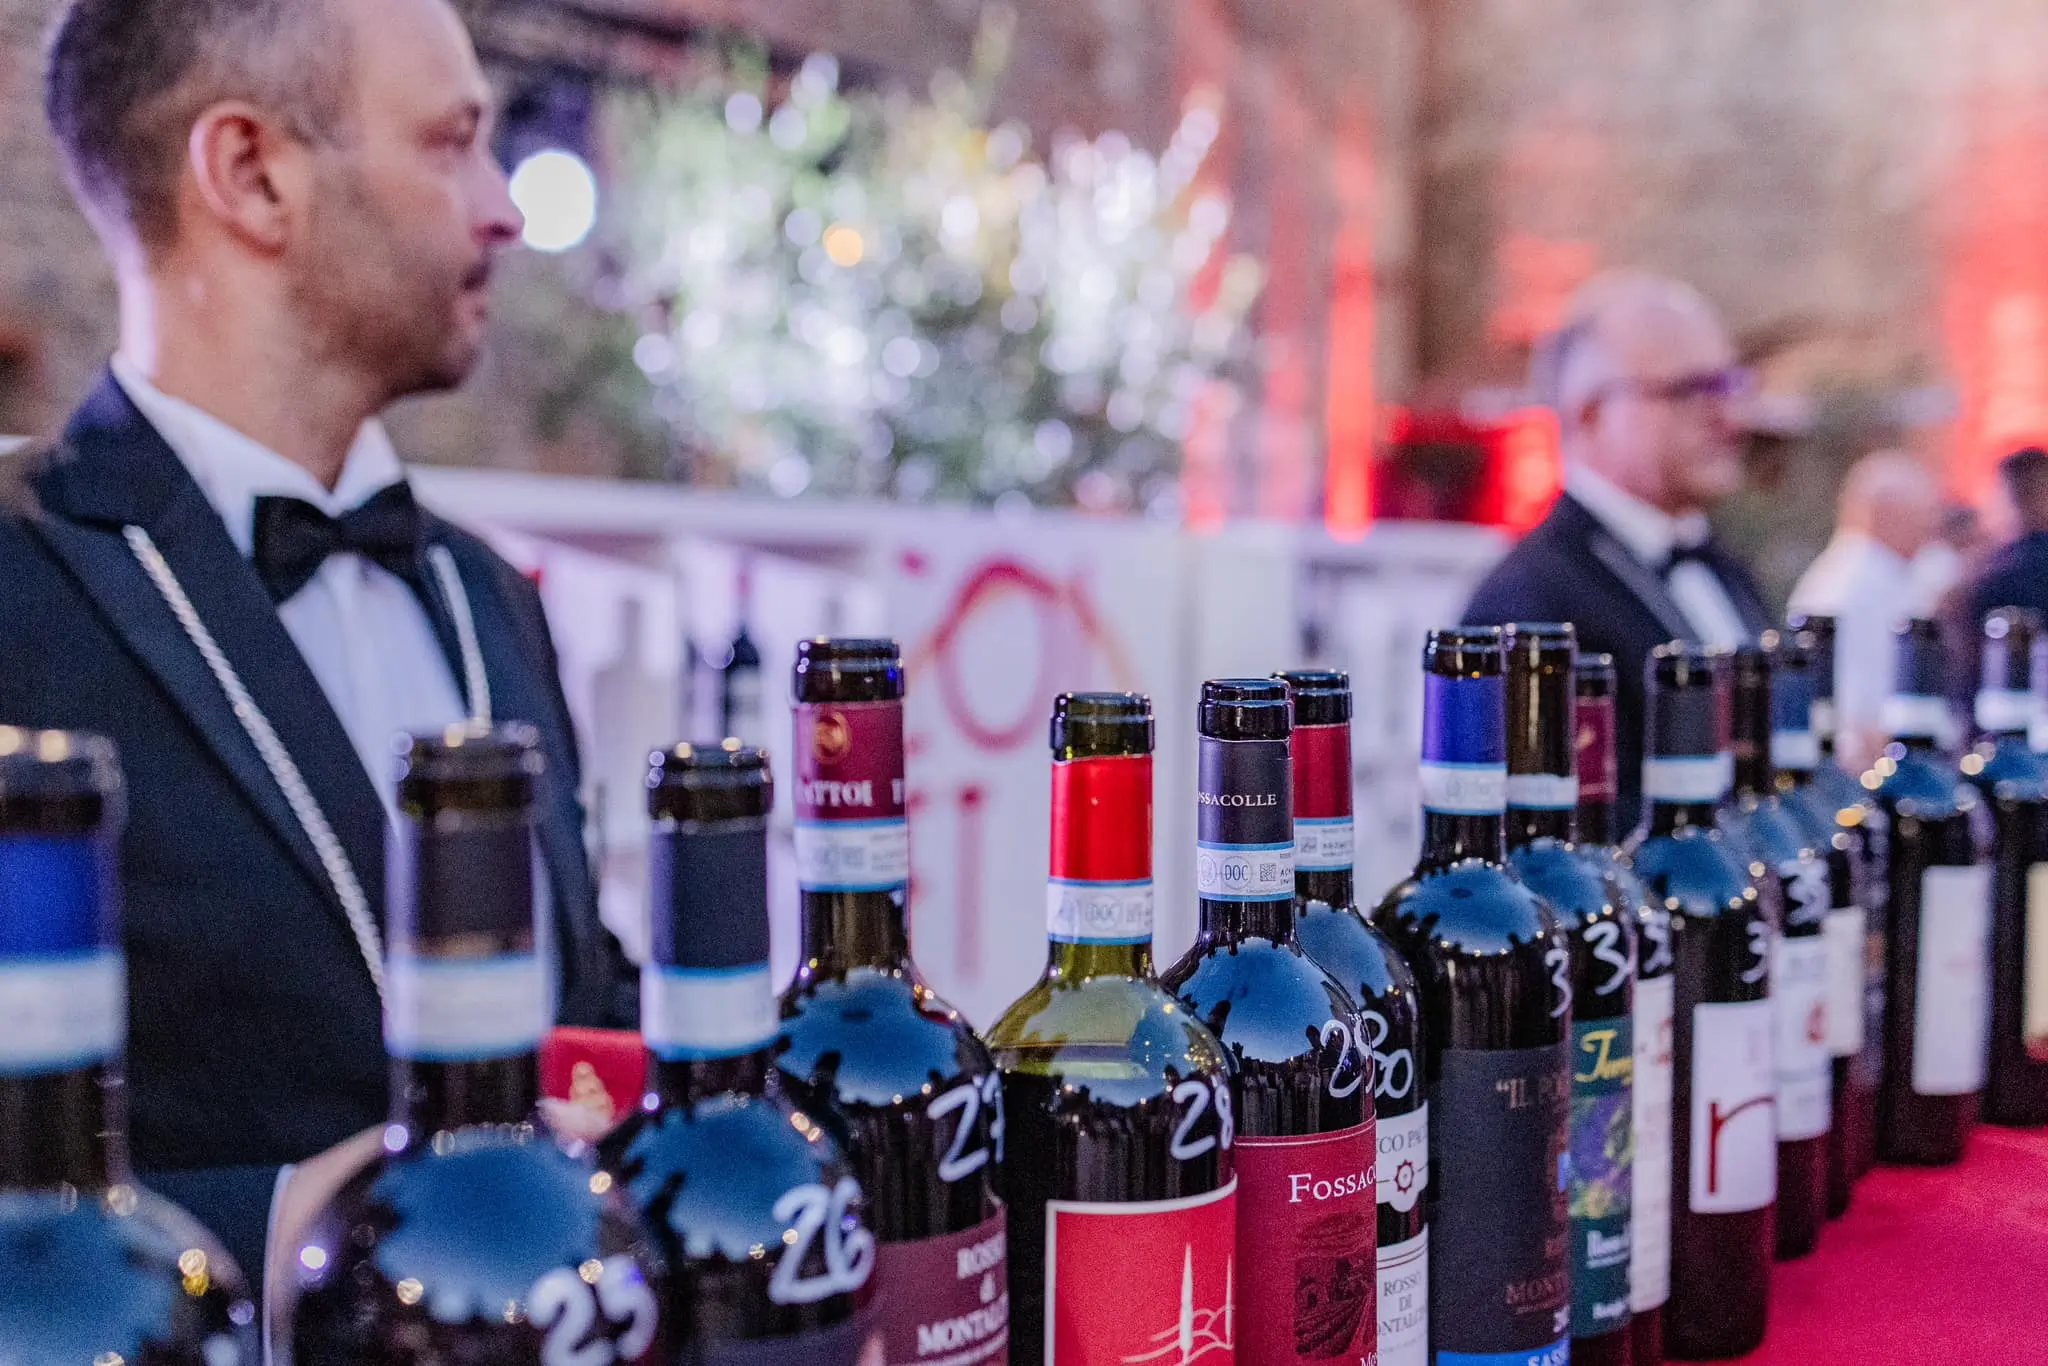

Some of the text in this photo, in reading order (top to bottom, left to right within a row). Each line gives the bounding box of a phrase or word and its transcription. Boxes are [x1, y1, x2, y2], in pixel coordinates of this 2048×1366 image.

[1224, 864, 1249, 881] DOC
[1170, 1080, 1235, 1160] 28
[768, 1175, 875, 1305] 26
[527, 1254, 659, 1366] 25
